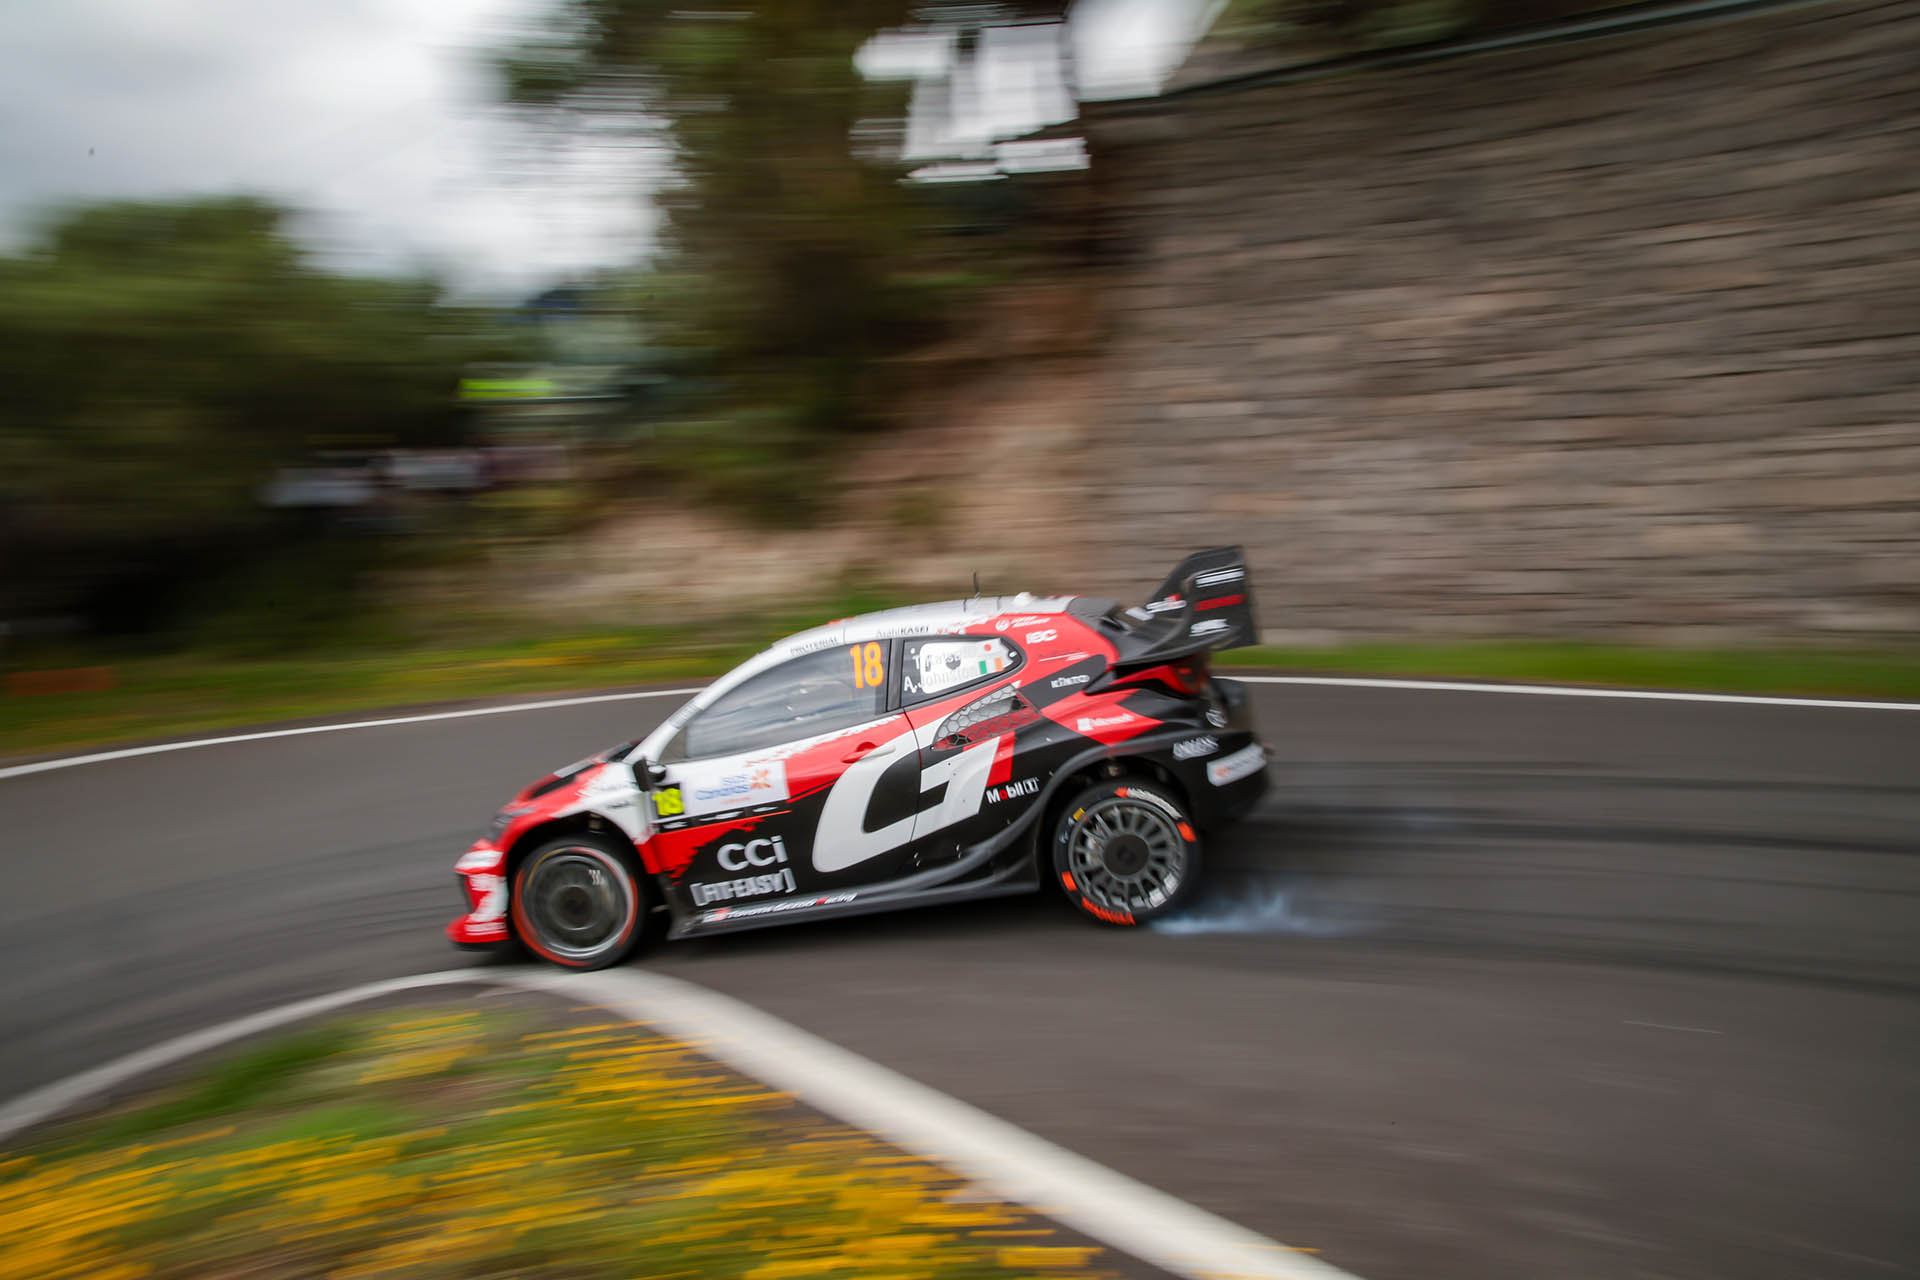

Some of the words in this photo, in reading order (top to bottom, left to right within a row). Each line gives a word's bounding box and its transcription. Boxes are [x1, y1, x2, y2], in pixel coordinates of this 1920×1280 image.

[850, 642, 884, 688] 18
[652, 788, 685, 815] 18
[986, 781, 1024, 804] Mobil
